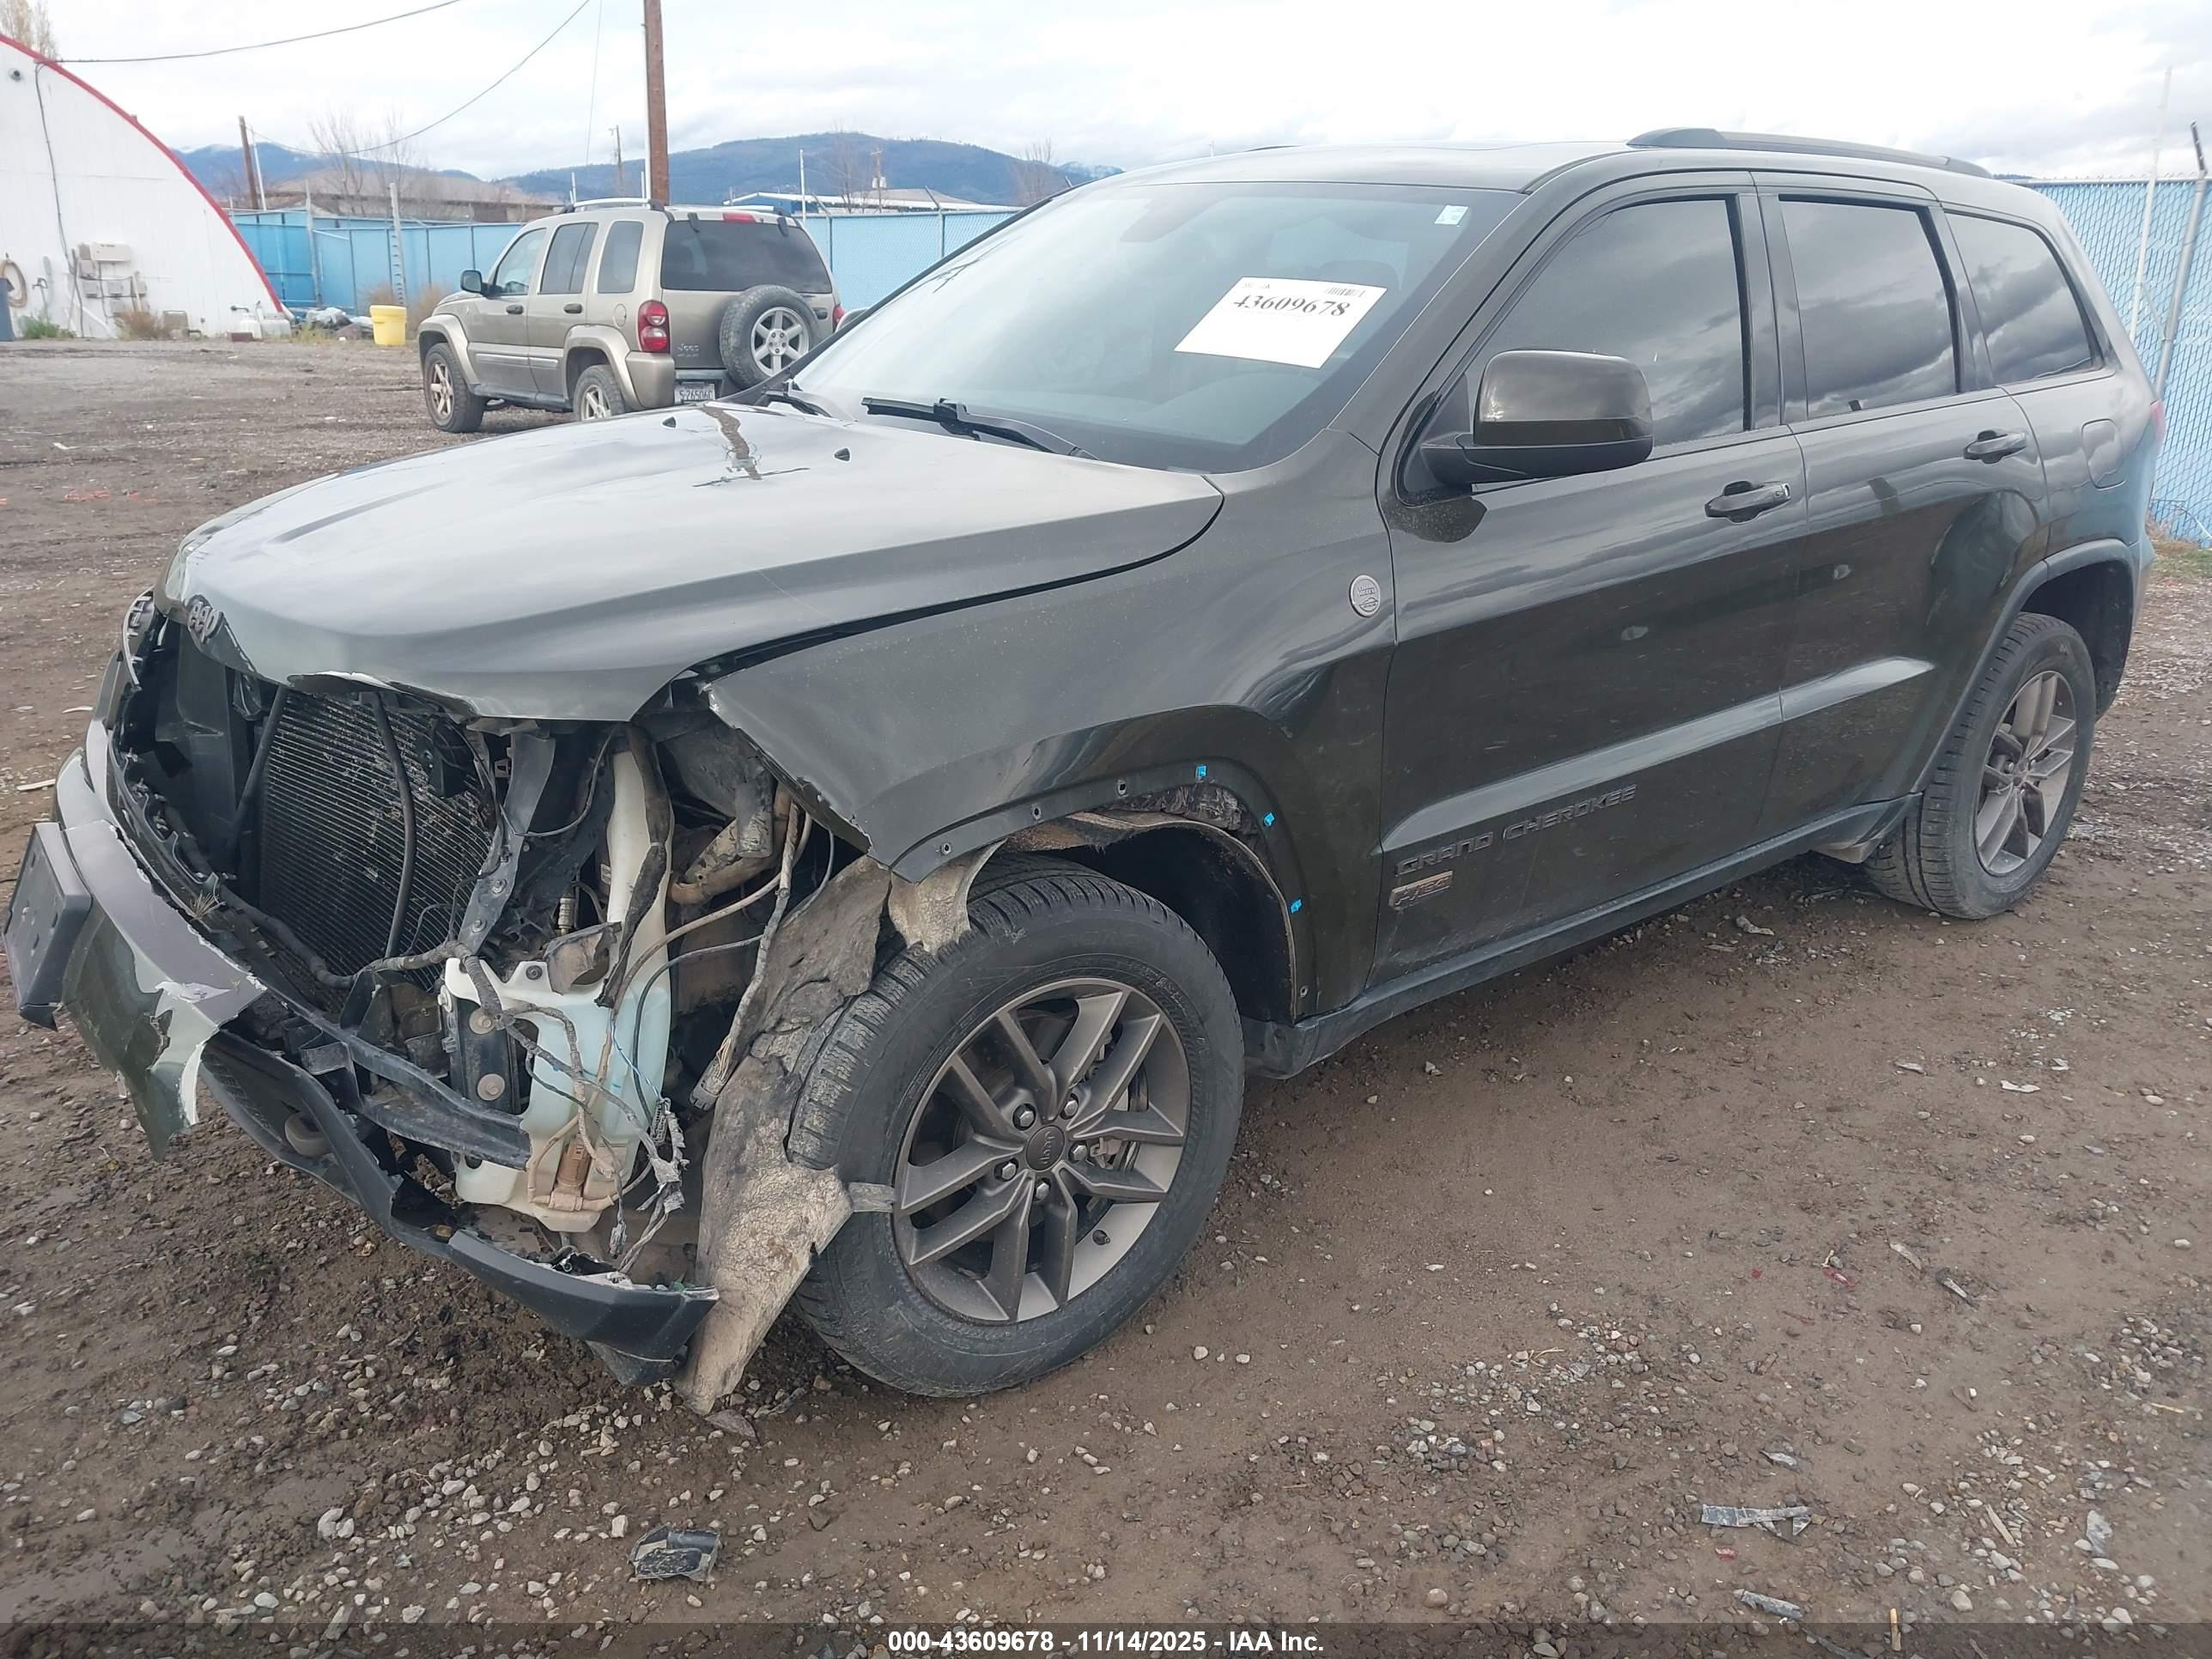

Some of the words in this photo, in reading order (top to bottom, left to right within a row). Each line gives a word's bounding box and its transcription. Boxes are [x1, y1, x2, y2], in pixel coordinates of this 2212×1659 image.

[1234, 295, 1351, 316] 43609678
[1394, 831, 1494, 877] GRAND
[1503, 784, 1638, 841] CHEROKEE
[1039, 1130, 1056, 1165] Jeep
